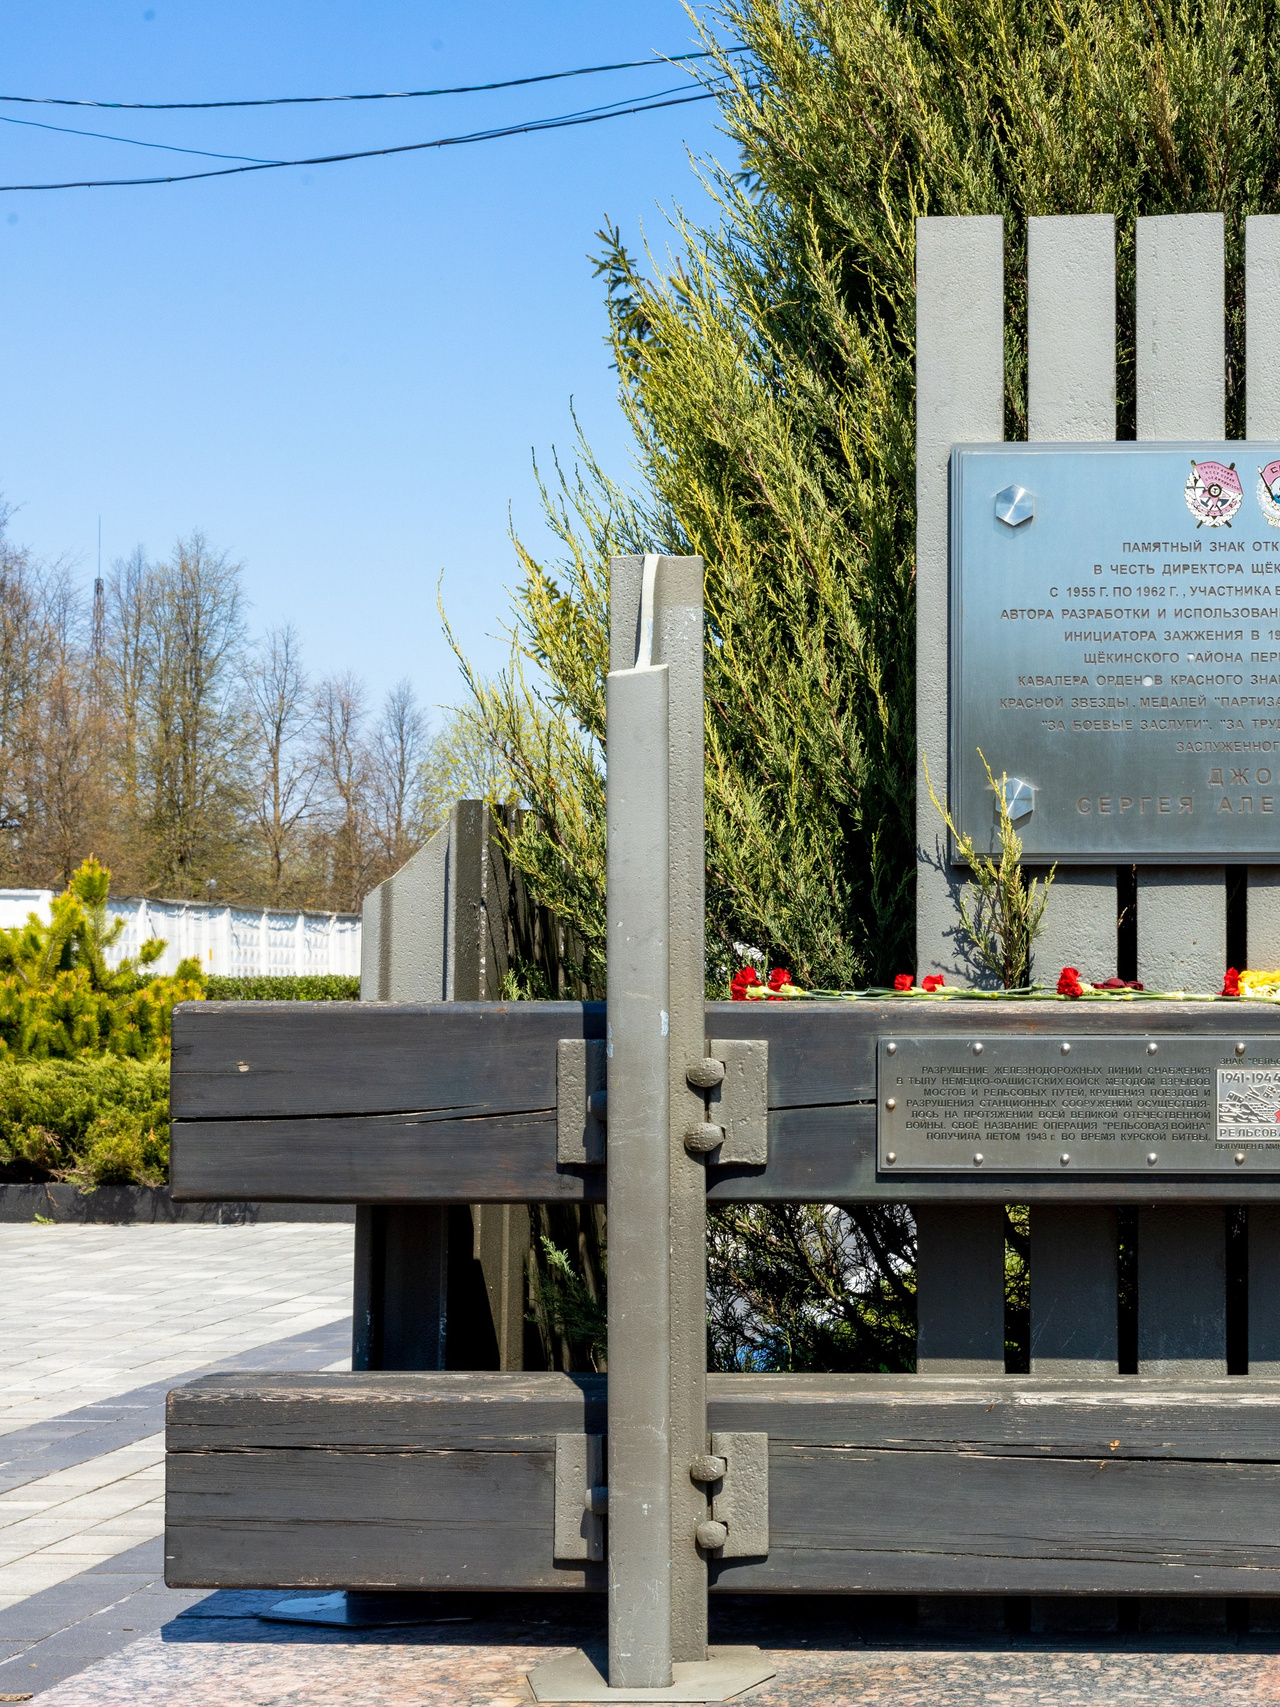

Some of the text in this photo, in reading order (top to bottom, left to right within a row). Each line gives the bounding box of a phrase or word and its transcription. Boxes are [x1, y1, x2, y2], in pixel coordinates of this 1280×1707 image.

[1122, 539, 1202, 553] ПАМЯТНЫЙ
[1209, 541, 1245, 552] ЗНАК
[1094, 564, 1103, 575] В
[1110, 564, 1155, 575] ЧЕСТЬ
[1162, 564, 1244, 576] ДИРЕКТОРА
[1049, 587, 1059, 598] С
[1066, 587, 1096, 597] 1955
[1113, 587, 1133, 597] ПО
[1136, 586, 1166, 597] 1962
[1189, 586, 1271, 597] УЧАСТНИКА
[1000, 609, 1054, 620] АВТОРА
[1061, 609, 1150, 620] РАЗРАБОТКИ
[1157, 608, 1166, 619] И
[1064, 631, 1157, 643] ИНИЦИАТОРА
[1163, 630, 1243, 641] ЗАЖЖЕНИЯ
[1251, 630, 1260, 641] В
[1083, 651, 1180, 665] ЩЁКИНСКОГО
[1018, 675, 1089, 686] КАВАЛЕРА
[1096, 675, 1163, 687] ОРДЕНВ
[1170, 675, 1243, 686] КРАСНОГО
[1000, 696, 1064, 709] КРАСНОЙ
[1139, 695, 1207, 709] МЕДАЛЕЙ
[1042, 720, 1065, 731] "ЗА
[1073, 720, 1133, 731] БОЕВЫЕ
[1220, 719, 1245, 730] "ЗА
[1076, 797, 1193, 815] СЕРГЕЯ
[921, 1065, 1211, 1076] РАЗРУШЕНИЕ ЖЕЛЕЗНОДОРОЖНЫХ ЛИНИЙ СНАБЖЕНИЯ
[908, 1076, 1211, 1087] ТЫЛУ НЕМЕЦКО-ФАШИСТСКИХ ВОЙСК МЕТОДОМ ВЗРЫВОВ
[923, 1089, 1199, 1098] МОСТОВ РЕЛЬСОВЫХ КРУШЕНИЯ ПОЕЗДОВ
[906, 1100, 974, 1108] РАЗРУШЕНИЯ
[979, 1100, 1057, 1109] СТАНЦИОННЫХ
[1061, 1098, 1133, 1108] СООРУЖЕНИЙ
[911, 1109, 1211, 1119] ЛОСЬ НА ПРОТЯЖЕНИИ ВСЕЙ ВЕЛИКОЙ ОТЕЧЕСТВЕННОЙ
[951, 1120, 979, 1130] СВОЁ
[984, 1122, 1038, 1130] НАЗВАНИЕ
[1043, 1122, 1098, 1131] ОПЕРАЦИЯ
[926, 1133, 981, 1141] ПОЛУЧИЛА
[985, 1133, 1020, 1141] ЛЕТОМ
[1026, 1133, 1047, 1141] 1943
[1061, 1133, 1075, 1141] ВО
[1080, 1133, 1116, 1141] ВРЕМЯ
[1120, 1131, 1166, 1141] КУРСКОЙ
